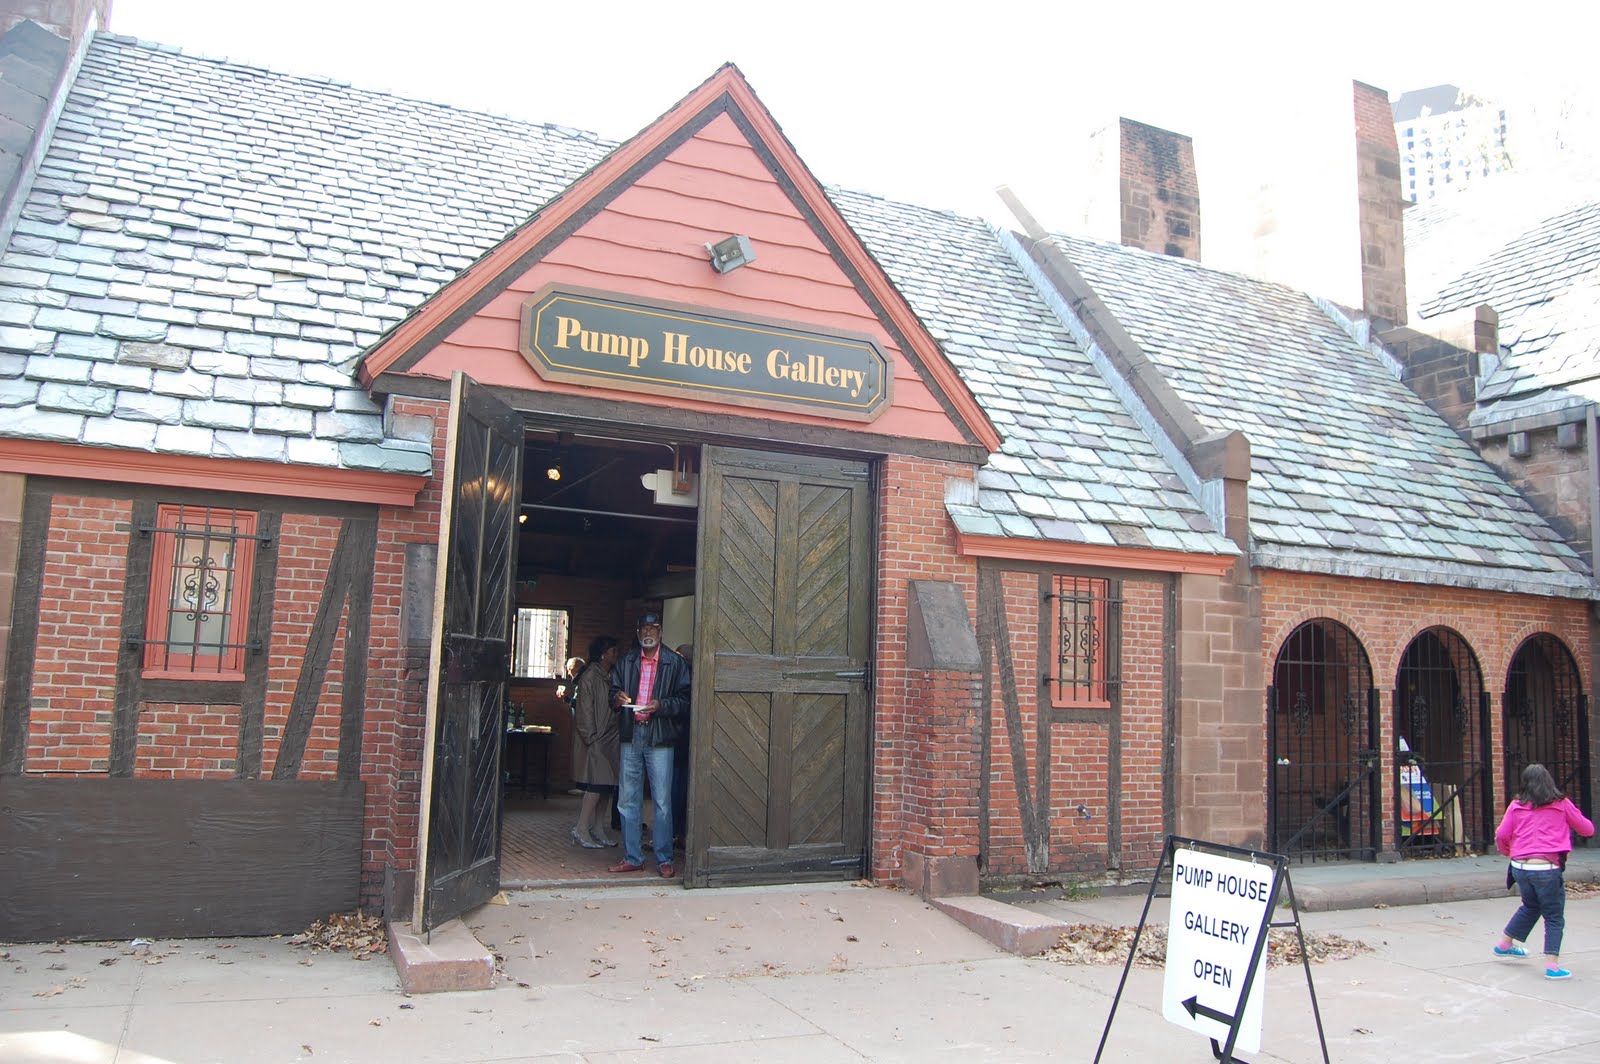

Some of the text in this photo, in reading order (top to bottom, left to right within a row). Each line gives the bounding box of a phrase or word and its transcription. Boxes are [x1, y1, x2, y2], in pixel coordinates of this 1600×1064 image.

[553, 315, 866, 398] Pump House Gallery
[1175, 864, 1268, 903] PUMP HOUSE
[1184, 910, 1249, 945] GALLERY
[1193, 959, 1232, 988] OPEN
